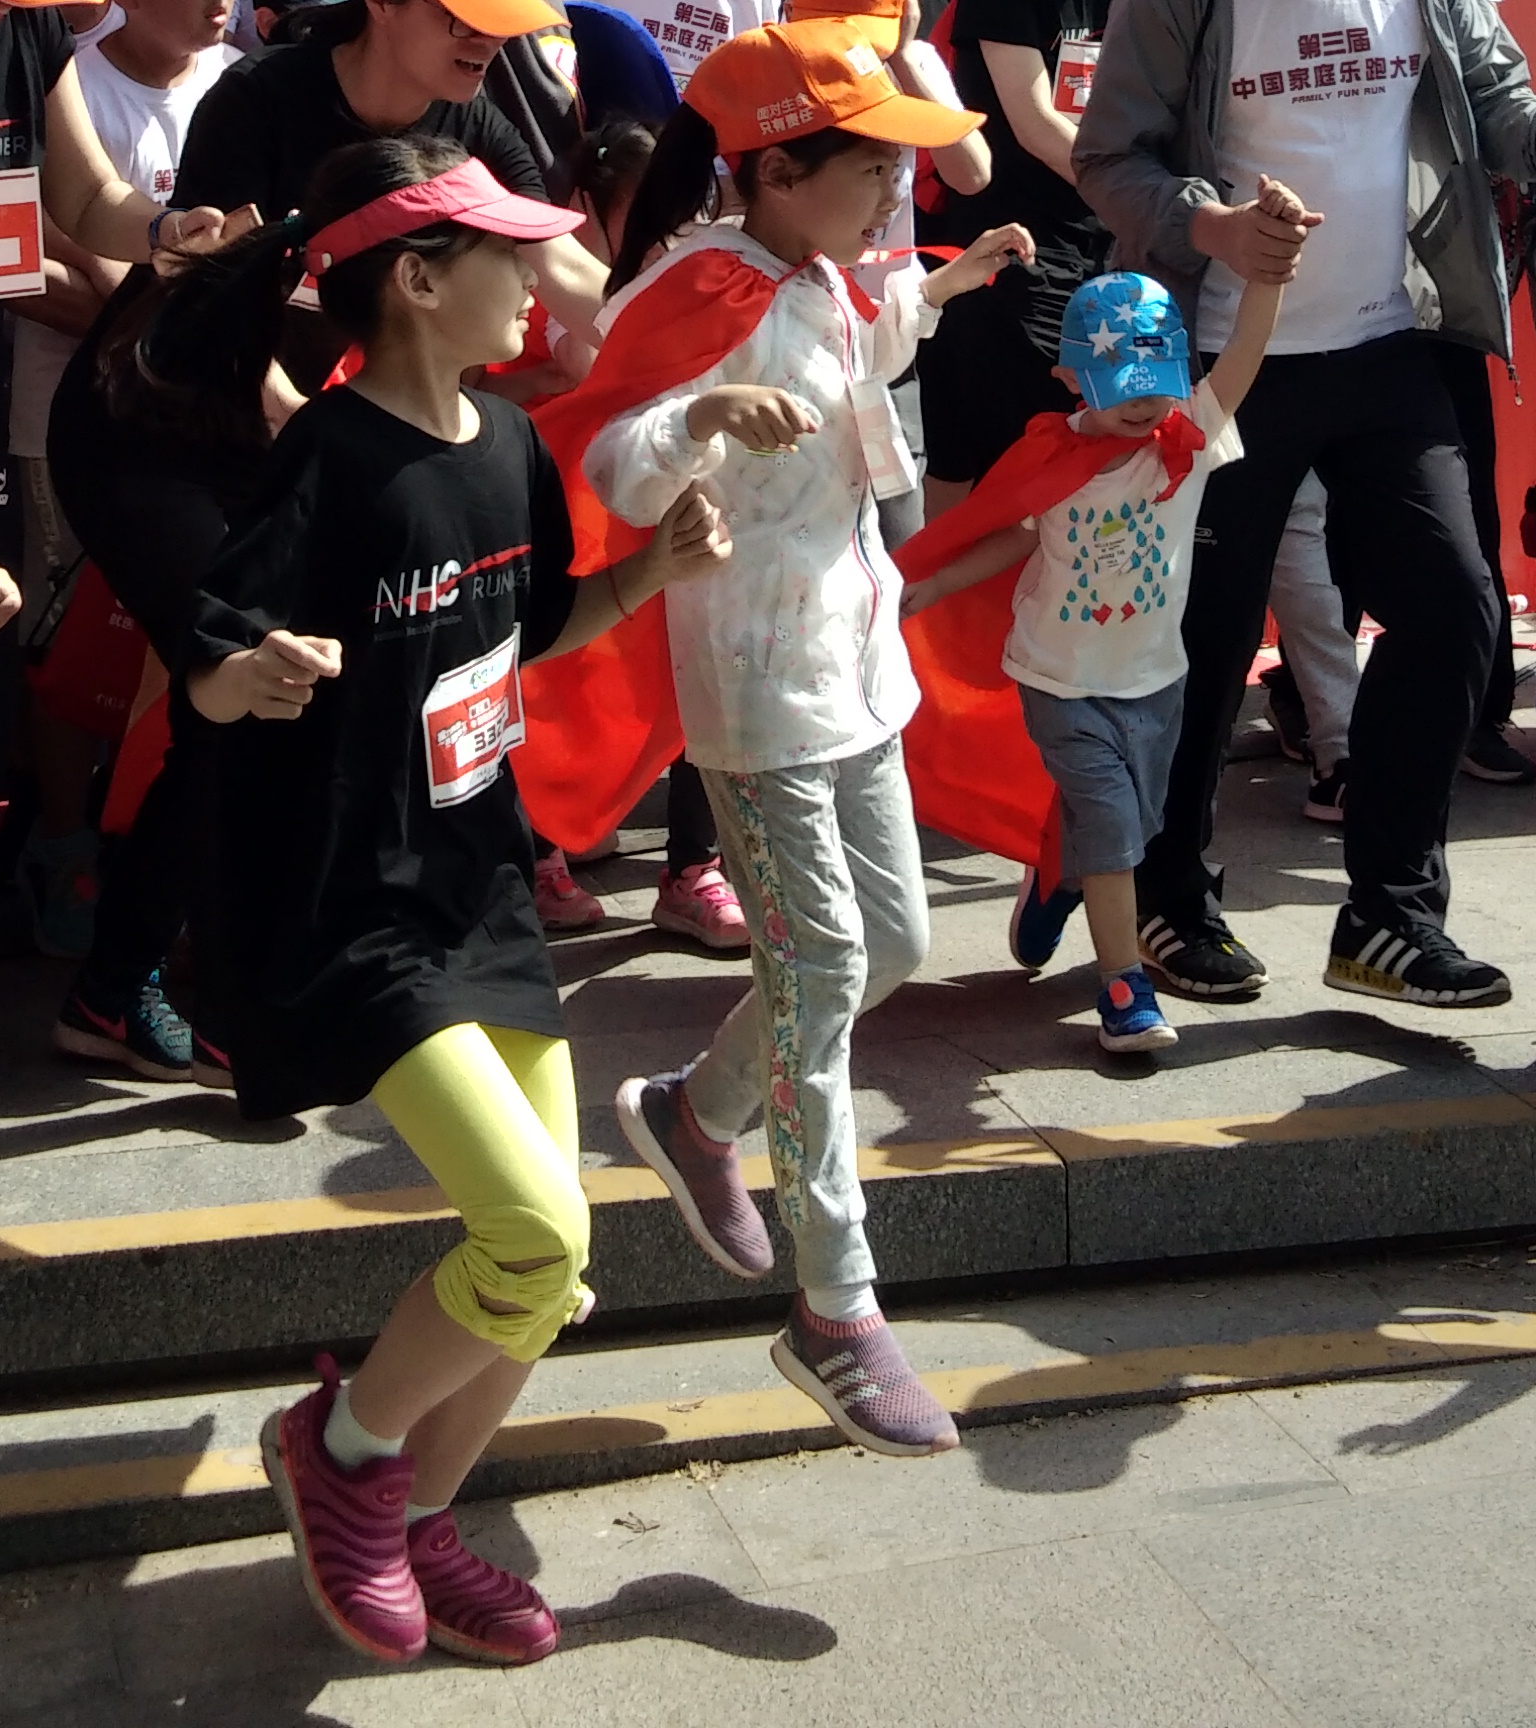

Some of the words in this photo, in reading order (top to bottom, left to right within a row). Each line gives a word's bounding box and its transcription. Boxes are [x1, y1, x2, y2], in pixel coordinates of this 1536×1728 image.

[674, 1, 730, 35] 第三届
[642, 18, 725, 53] 国家庭乐
[1297, 27, 1371, 60] 第三届
[1292, 92, 1332, 104] FAMILY
[1337, 88, 1360, 99] FUN
[1363, 85, 1387, 97] RUN
[374, 560, 462, 624] NHC
